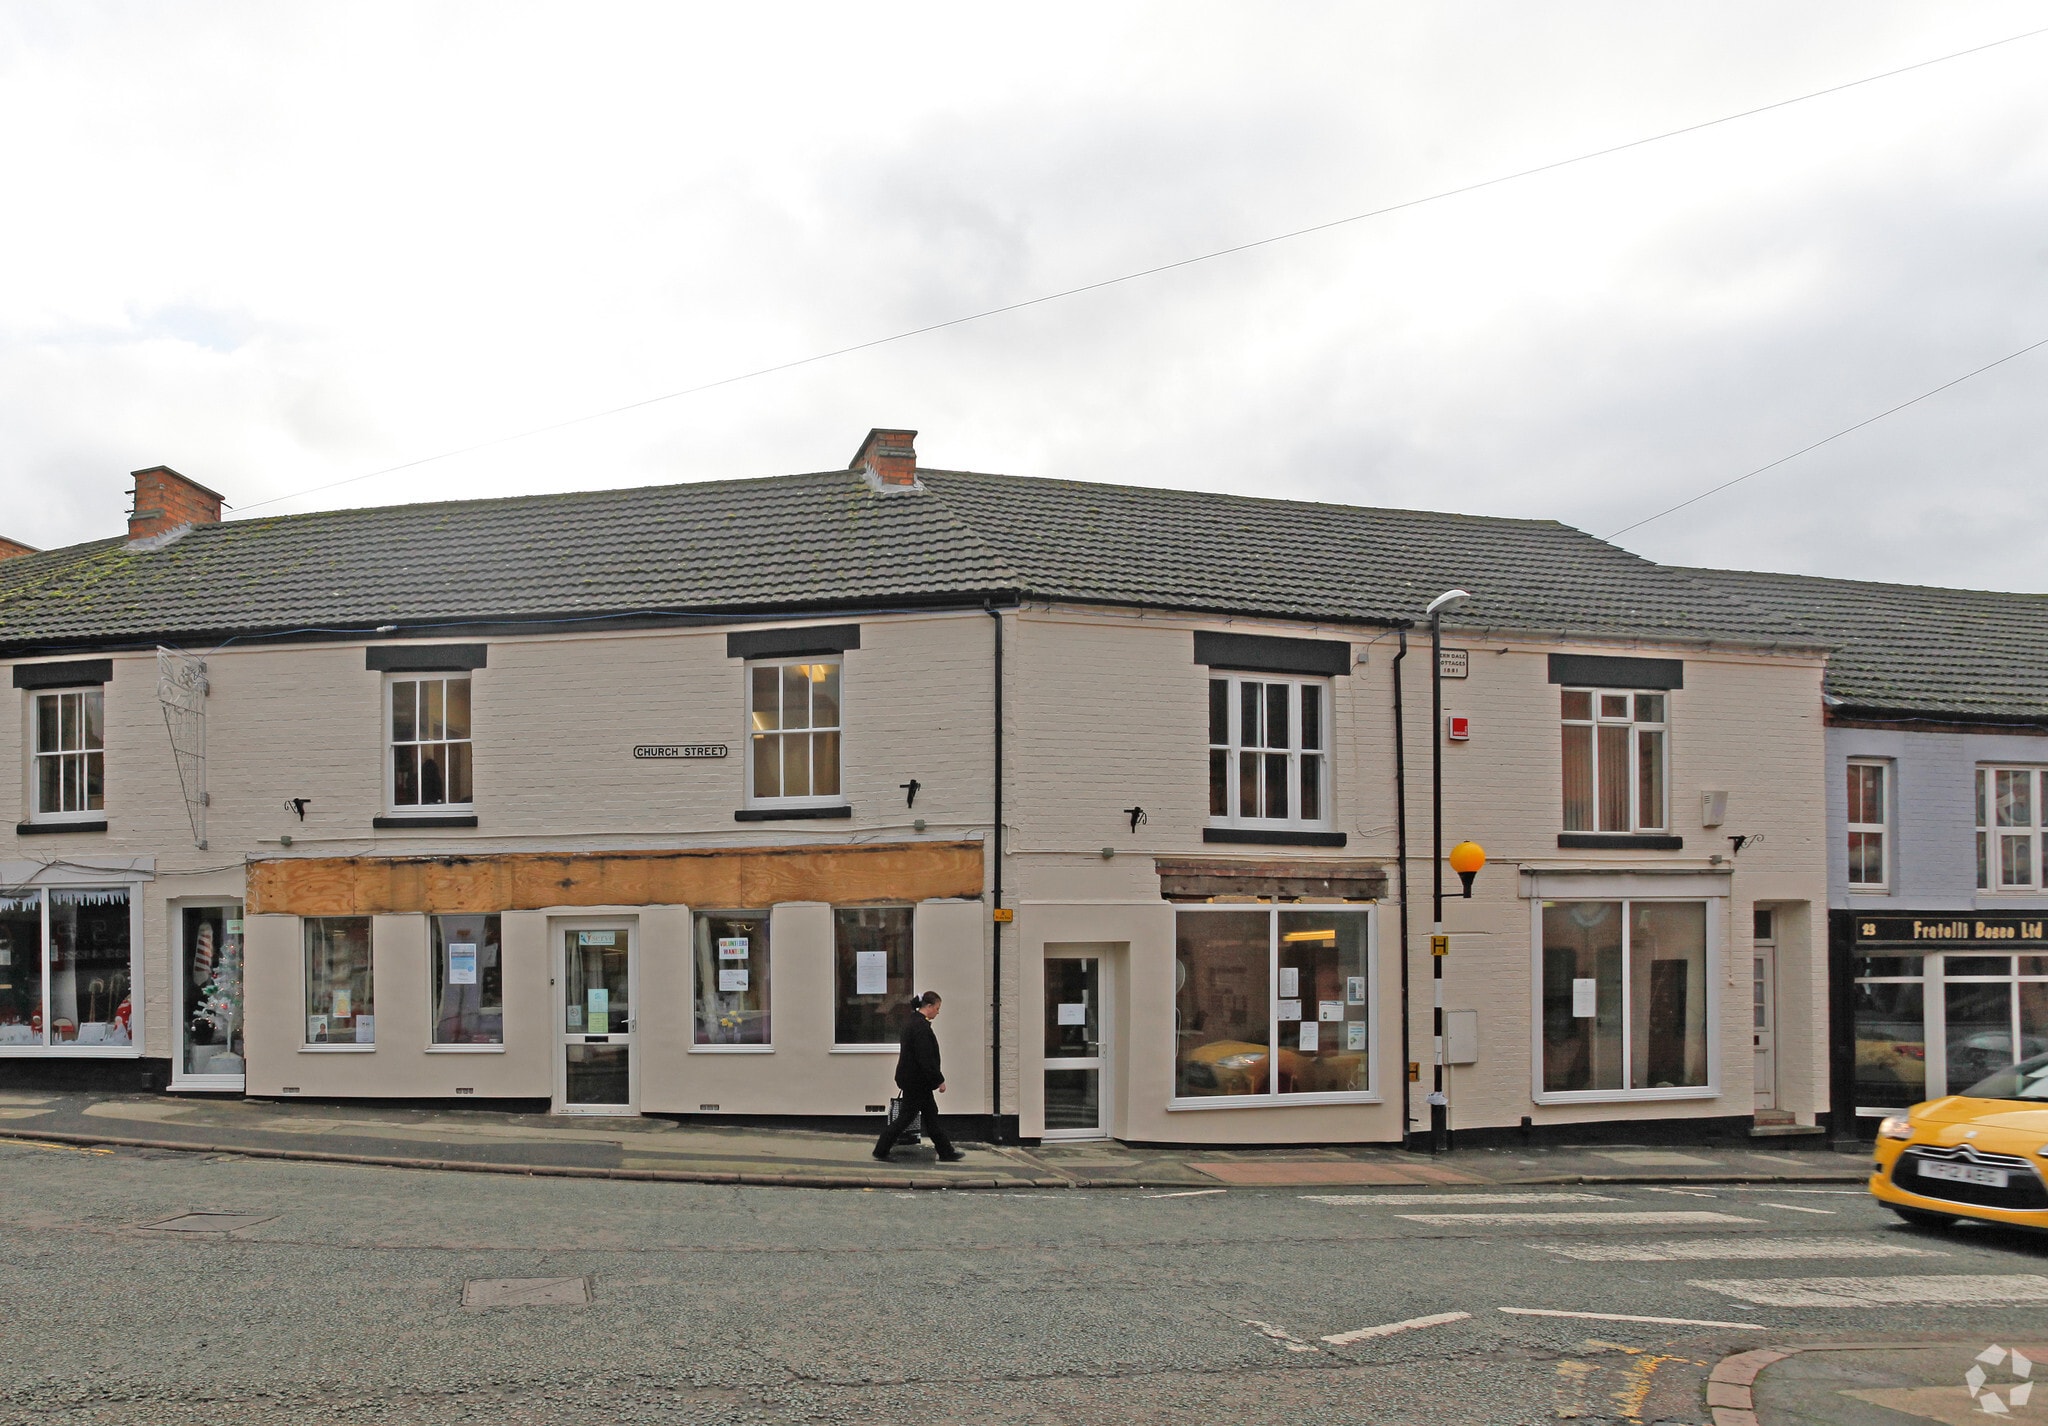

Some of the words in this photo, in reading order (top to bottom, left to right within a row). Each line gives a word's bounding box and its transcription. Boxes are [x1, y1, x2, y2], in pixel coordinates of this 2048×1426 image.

[637, 747, 678, 757] CHURCH
[684, 747, 724, 756] STREET
[1862, 923, 1876, 936] 23
[1913, 920, 1968, 939] Fratelli
[2020, 921, 2043, 939] Ltd
[1433, 937, 1446, 953] H
